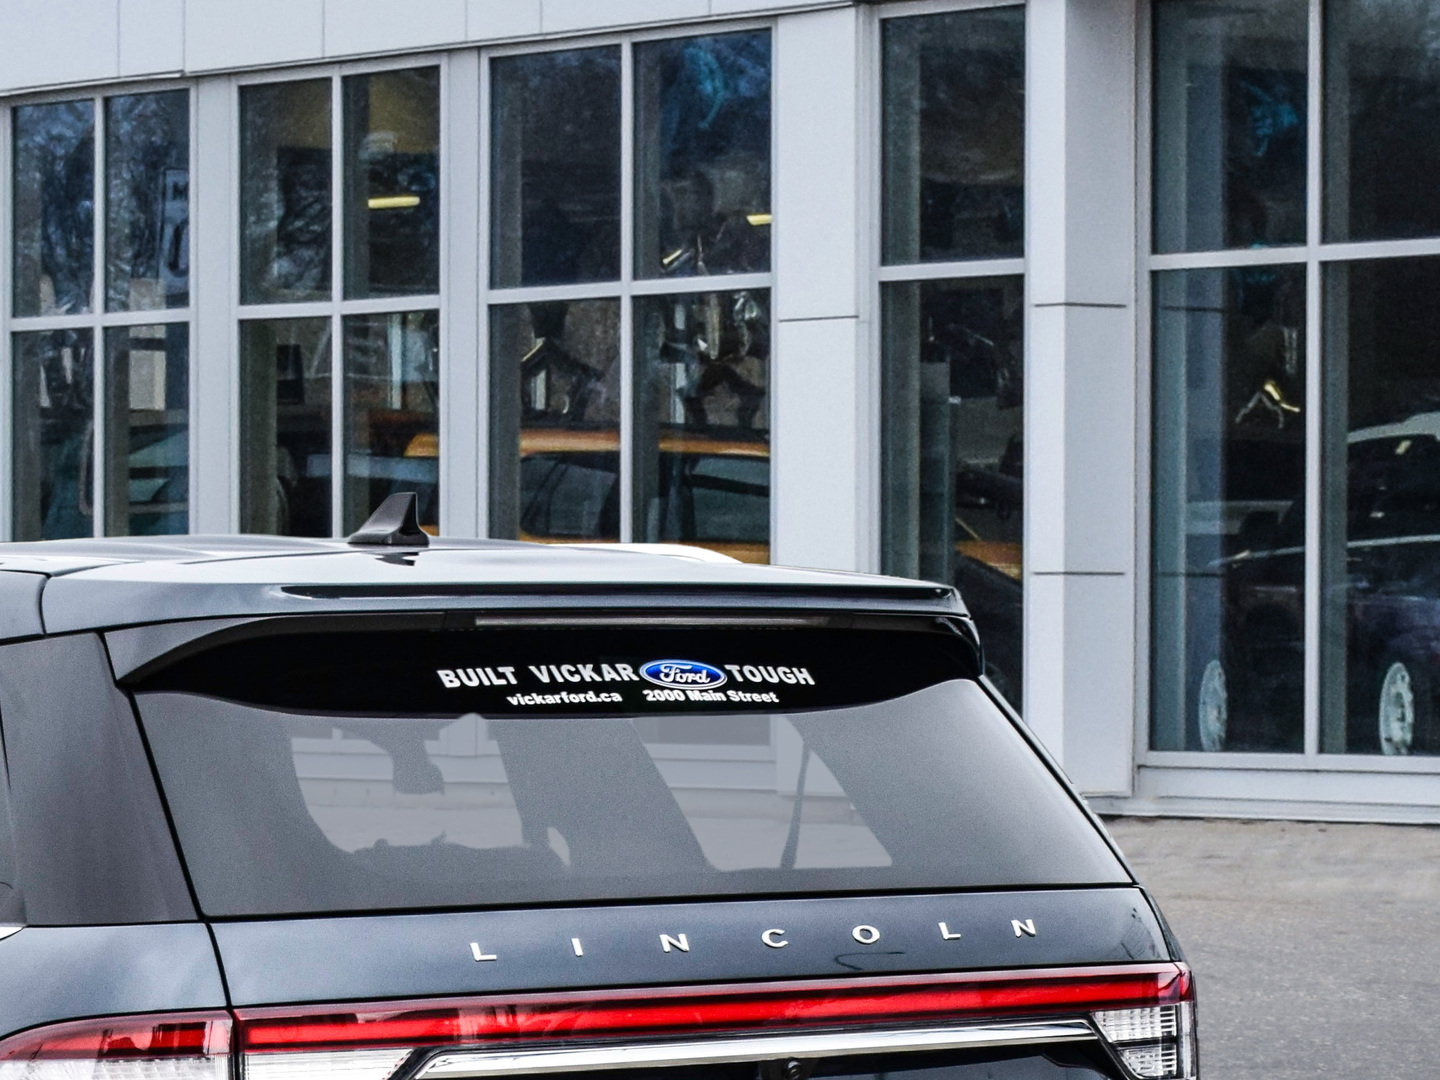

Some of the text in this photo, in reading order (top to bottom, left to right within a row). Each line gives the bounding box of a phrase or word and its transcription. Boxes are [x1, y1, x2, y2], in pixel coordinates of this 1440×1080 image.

[437, 663, 815, 688] BUILT VICKAR Ford TOUGH
[506, 690, 779, 706] vickarford.ca 2000 Main Street
[471, 919, 1036, 961] LINCOLN
